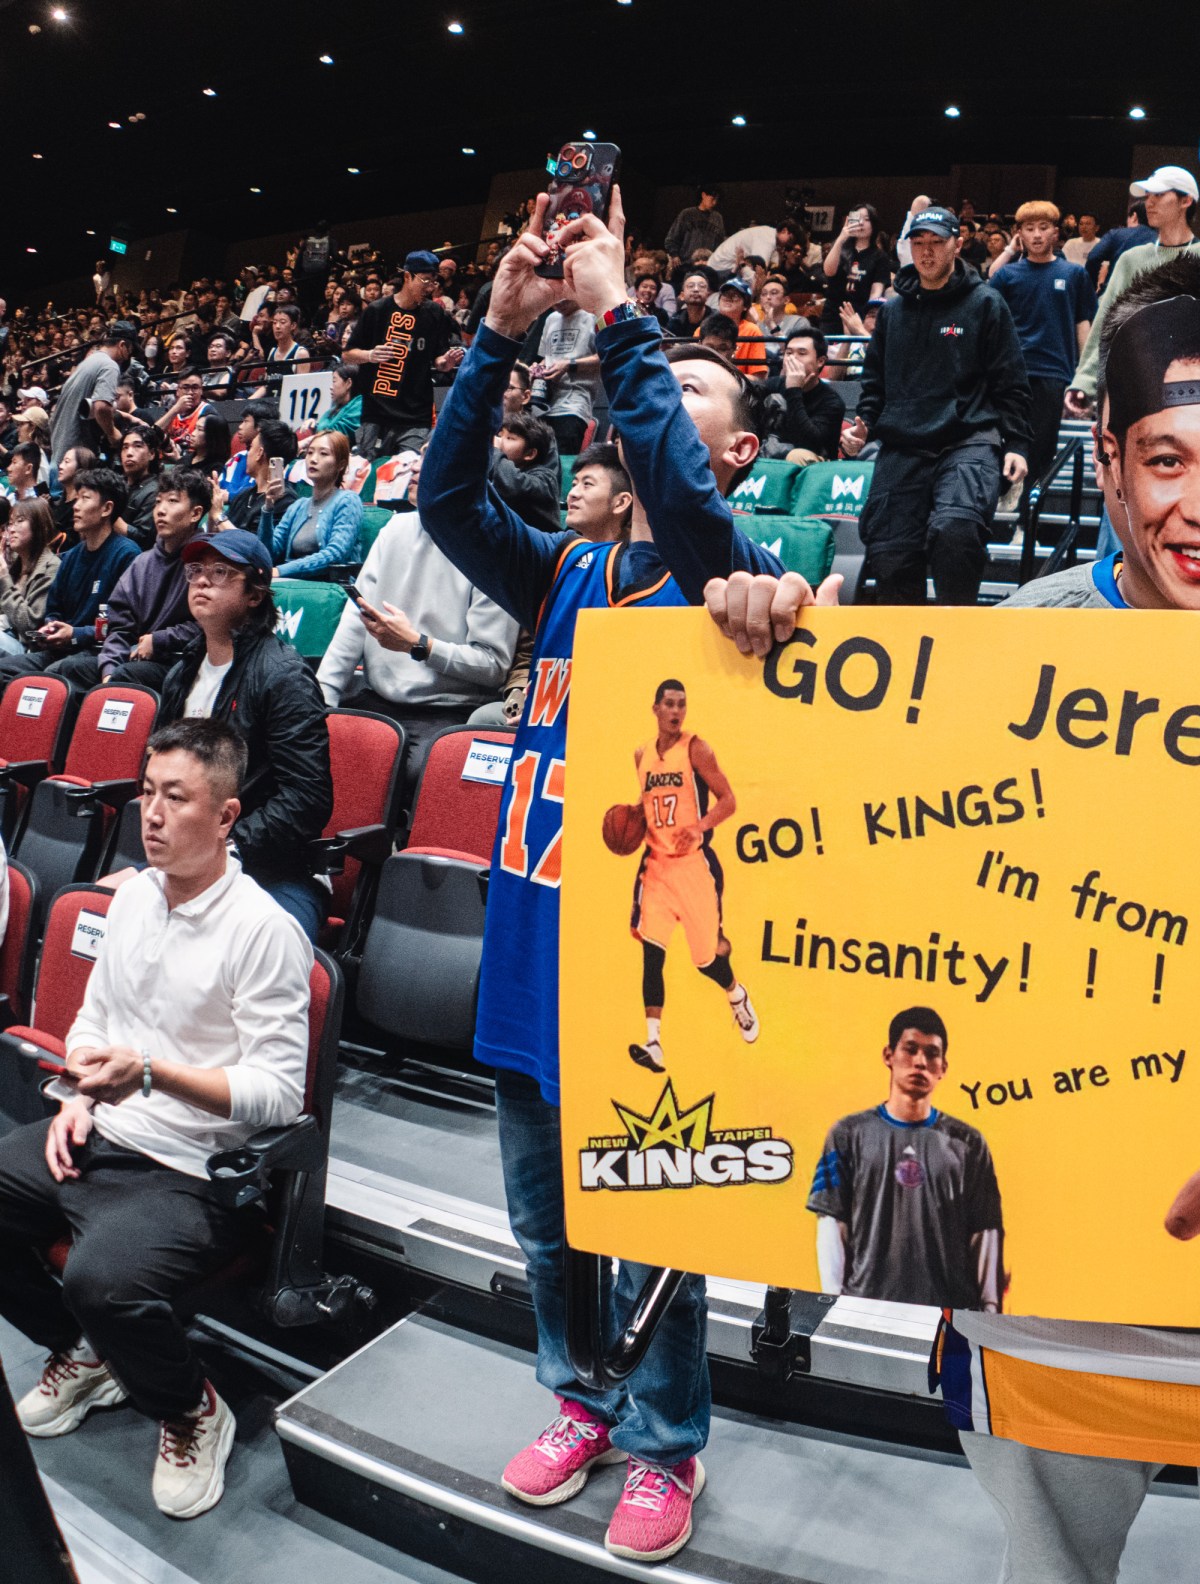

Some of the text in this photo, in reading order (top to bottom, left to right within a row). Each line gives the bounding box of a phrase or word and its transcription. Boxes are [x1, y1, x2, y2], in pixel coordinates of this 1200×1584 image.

[916, 212, 943, 222] JAPAN
[373, 311, 416, 397] PILOTS
[289, 387, 322, 421] 112
[762, 626, 934, 725] GO!
[470, 751, 511, 765] RESERVE
[653, 793, 679, 829] 17
[736, 768, 1046, 864] GO! KINGS!
[975, 850, 1040, 902] I'm
[1070, 870, 1189, 945] from
[78, 923, 106, 939] RESERV
[761, 918, 1166, 1005] Linsanity! ! !
[960, 1077, 1033, 1110] You
[1054, 1064, 1110, 1096] are
[1131, 1048, 1186, 1083] my
[589, 1128, 772, 1149] NEW TAIPEI
[579, 1139, 795, 1191] KINGS
